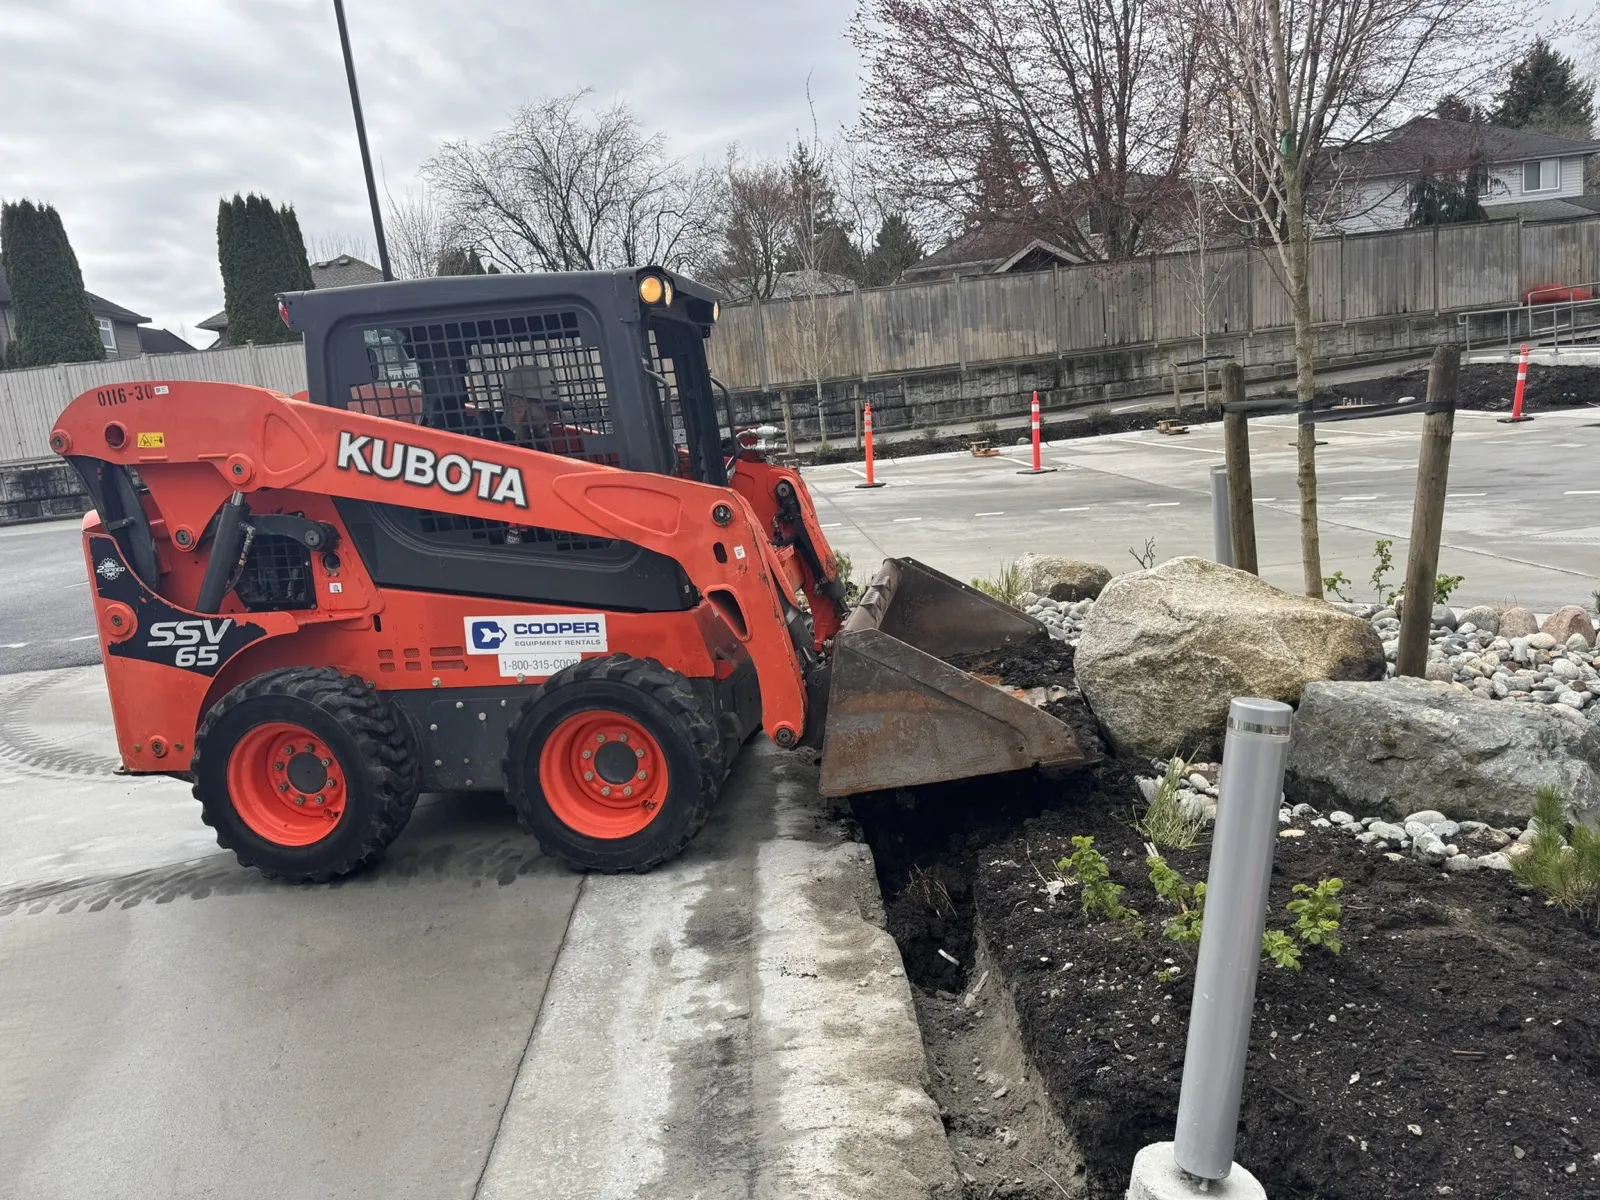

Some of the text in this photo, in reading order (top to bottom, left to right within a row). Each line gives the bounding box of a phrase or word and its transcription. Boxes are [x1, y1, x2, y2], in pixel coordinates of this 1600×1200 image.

[97, 384, 153, 406] 0116-30
[336, 431, 528, 508] KUBOTA
[147, 618, 233, 647] SSV
[513, 622, 600, 635] COOPER
[175, 645, 220, 667] 65
